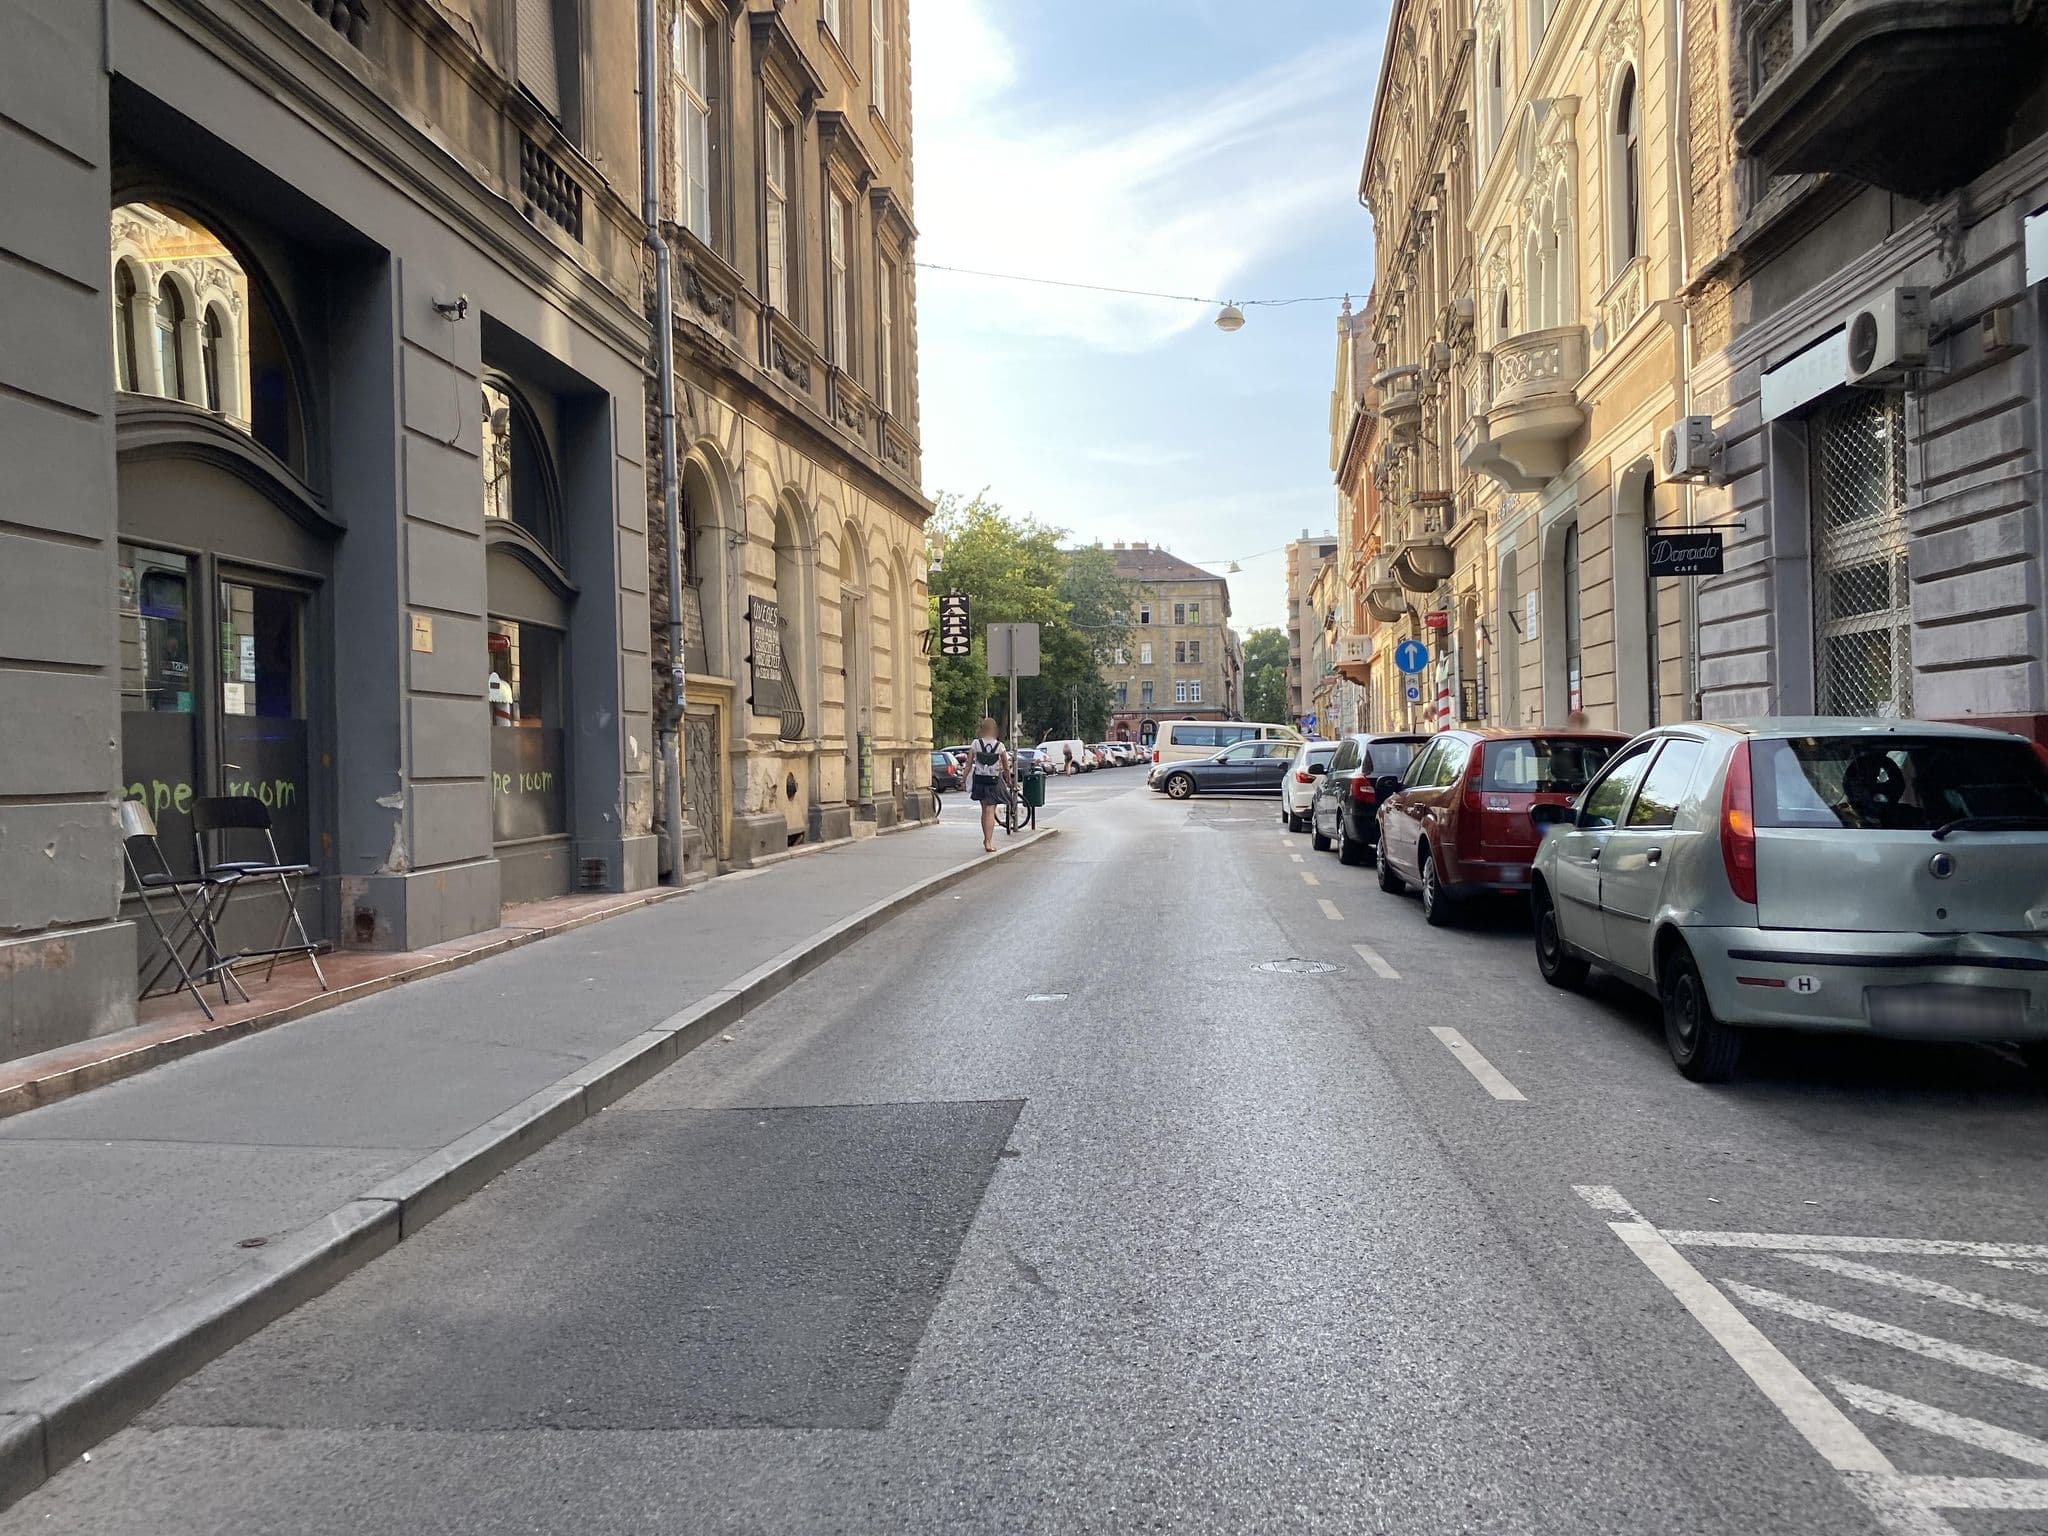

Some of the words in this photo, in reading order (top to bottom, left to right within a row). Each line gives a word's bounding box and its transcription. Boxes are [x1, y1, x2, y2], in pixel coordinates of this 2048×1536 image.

[1651, 537, 1720, 565] Dorado
[1674, 564, 1698, 572] CAFÉ
[941, 597, 969, 655] TATTOO
[229, 779, 296, 809] room
[519, 771, 552, 794] room
[1798, 977, 1811, 991] H
